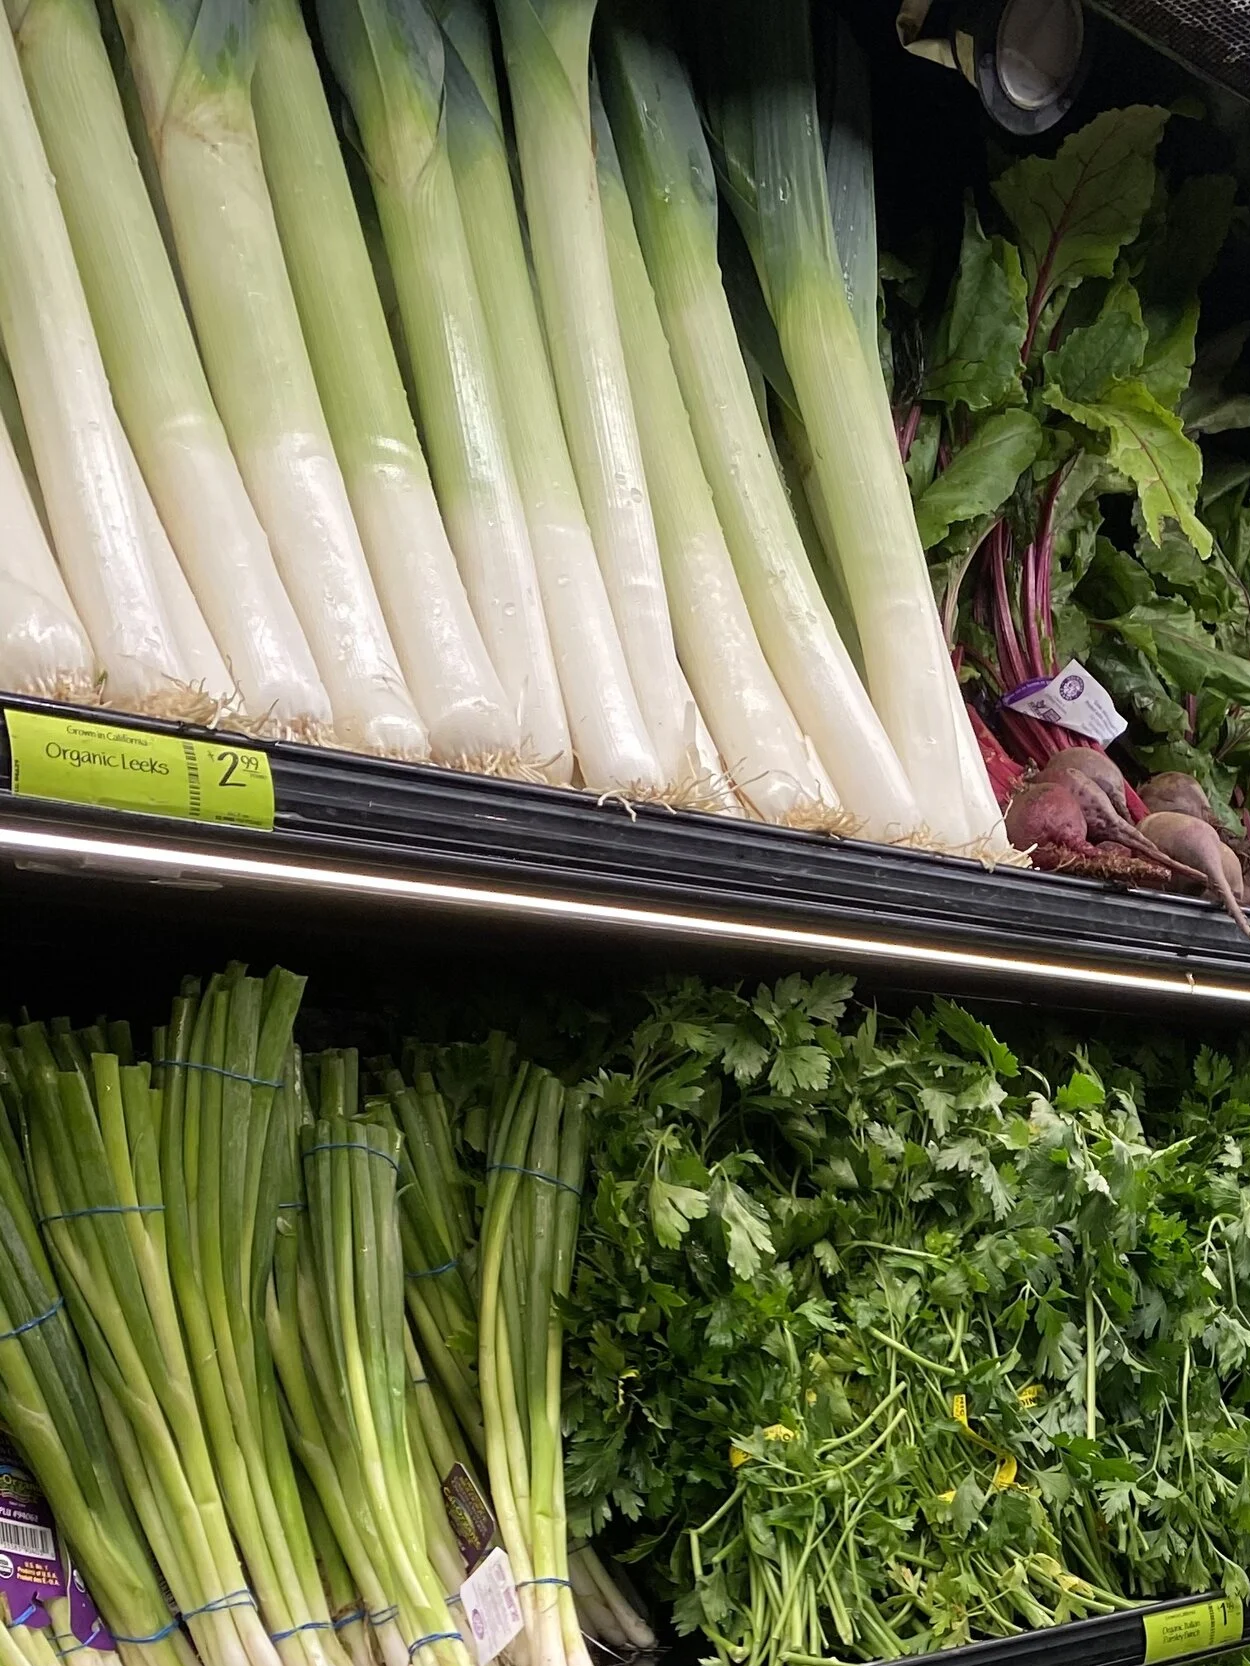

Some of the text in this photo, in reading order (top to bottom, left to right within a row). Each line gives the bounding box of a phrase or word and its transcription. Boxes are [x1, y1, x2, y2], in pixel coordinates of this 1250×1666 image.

[106, 731, 148, 746] California
[45, 741, 170, 776] Organic Leeks
